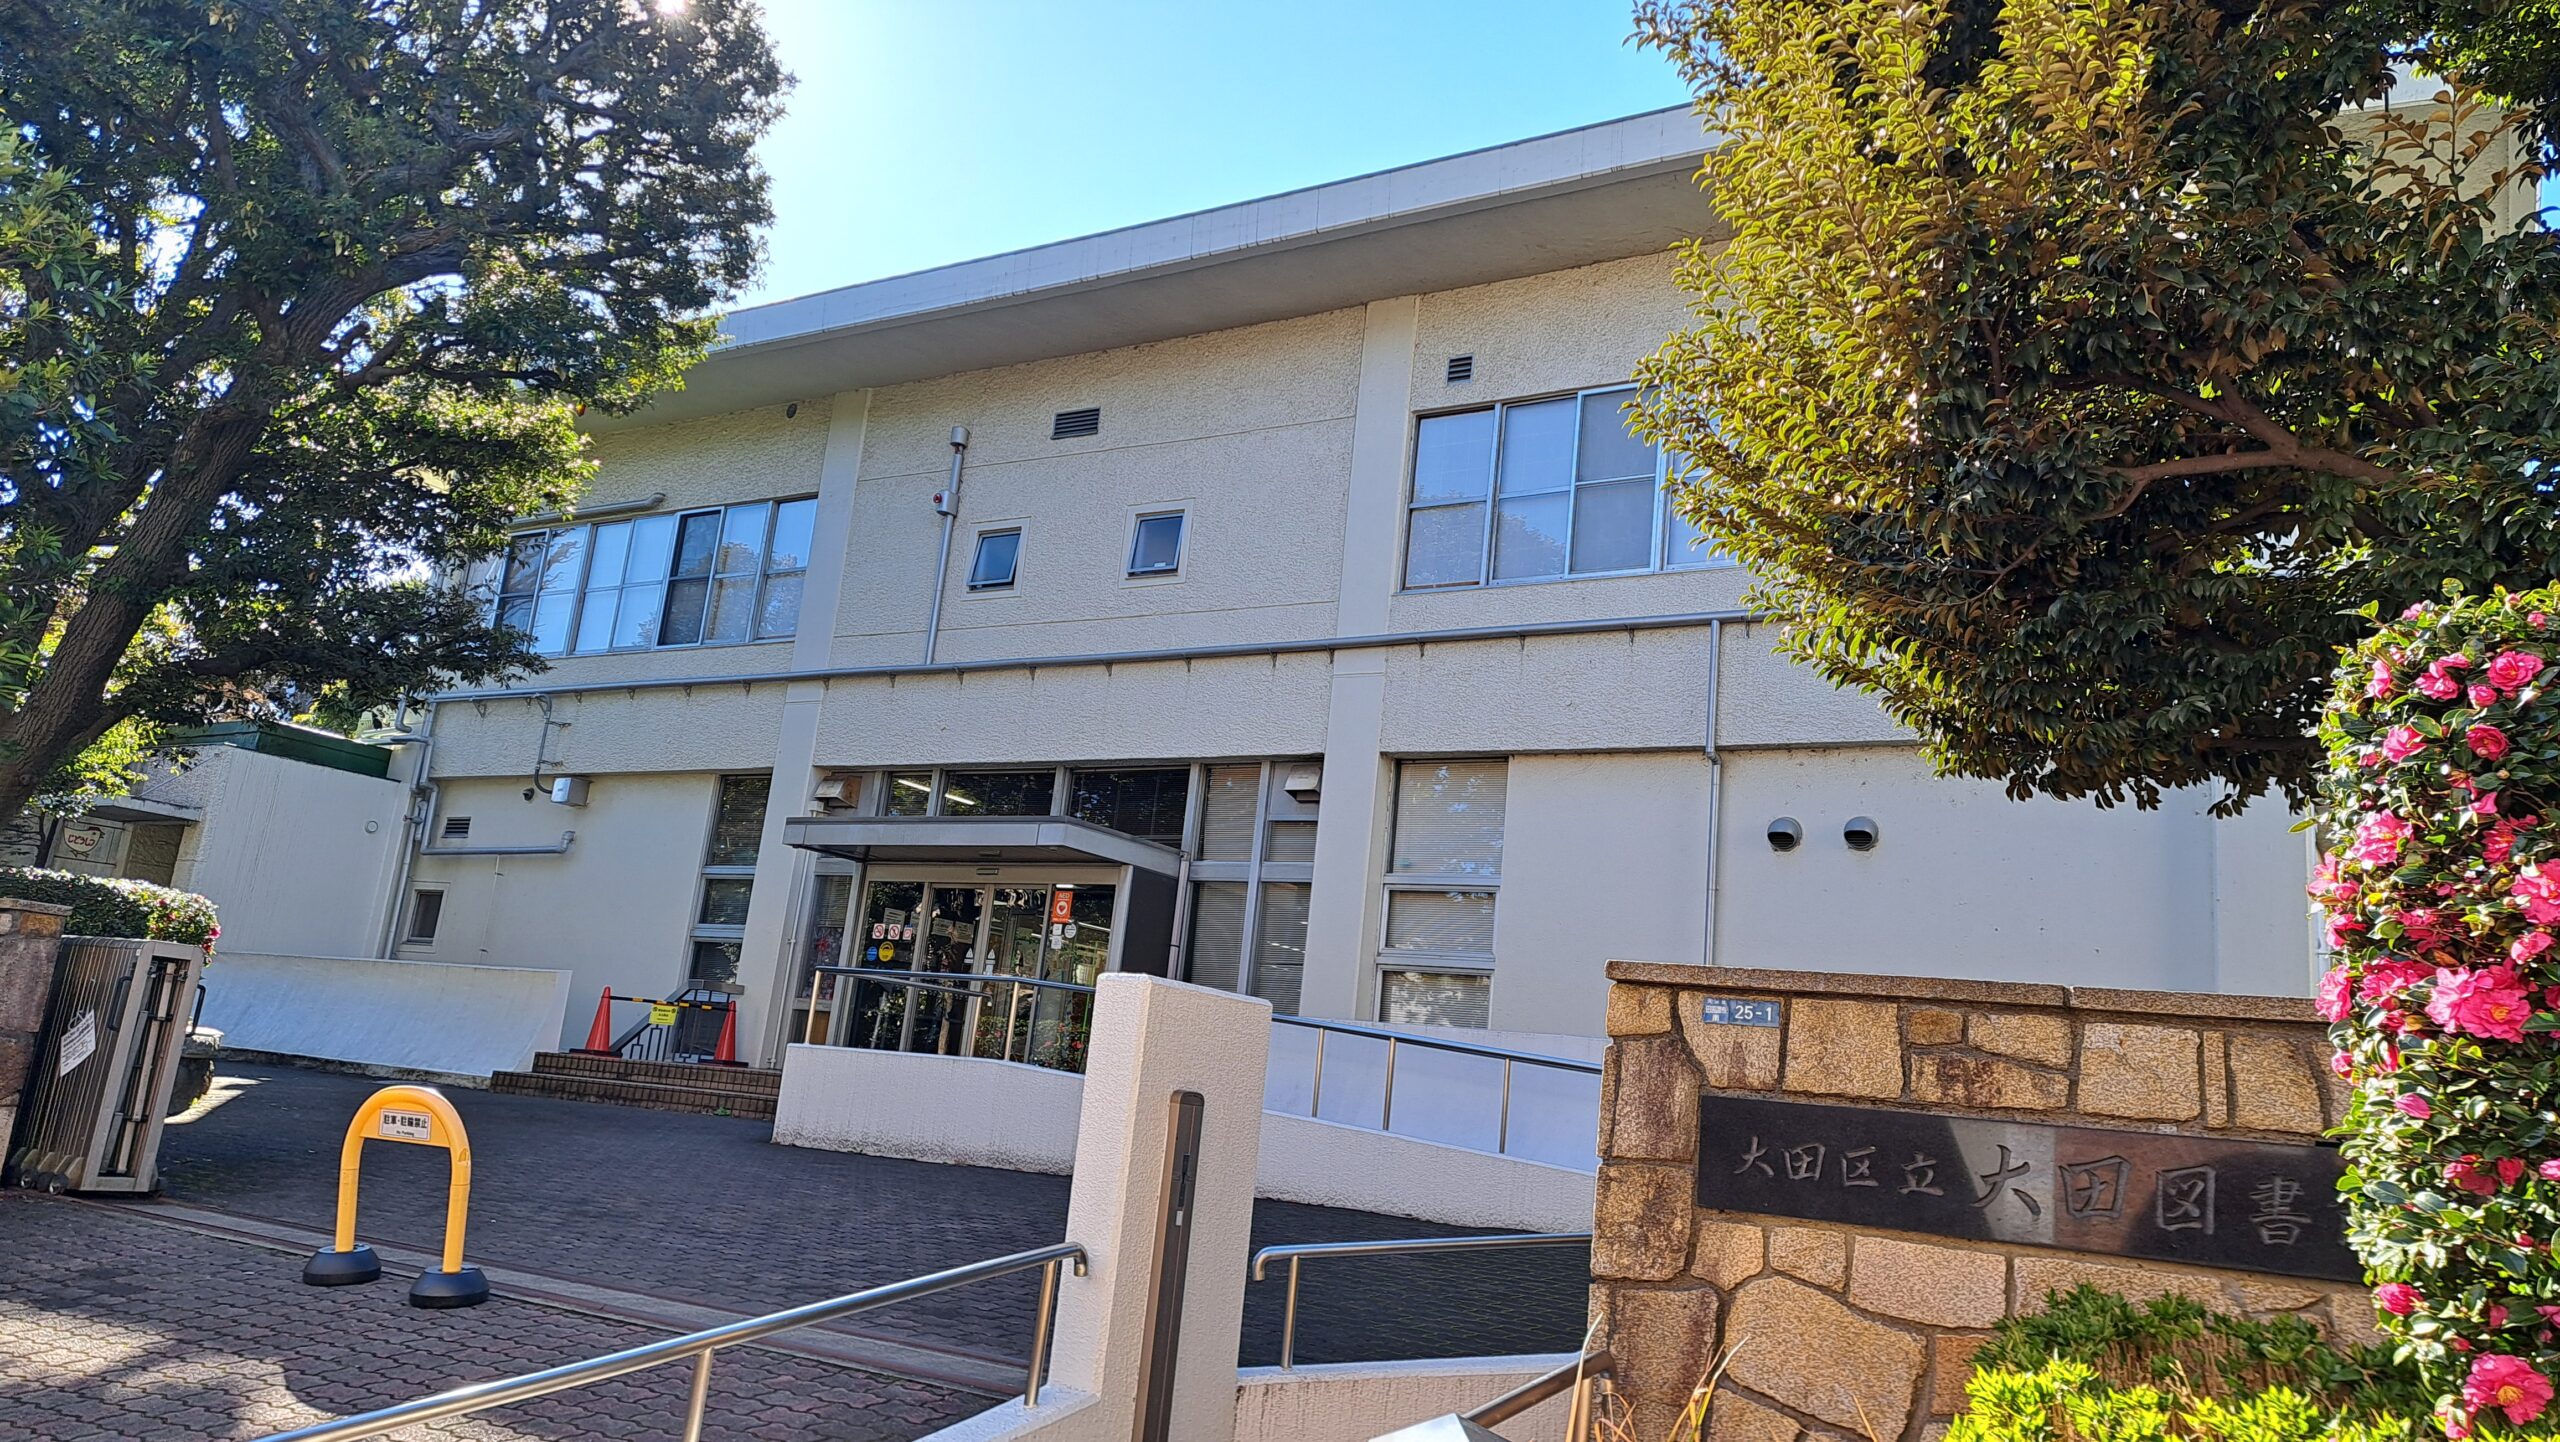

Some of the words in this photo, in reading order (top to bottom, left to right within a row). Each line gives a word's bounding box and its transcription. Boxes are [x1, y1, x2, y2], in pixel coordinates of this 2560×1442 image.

[67, 834, 96, 847] じどうしつ
[1734, 1005, 1773, 1022] 25-1
[1733, 1135, 2350, 1248] 大田区立大田図書
